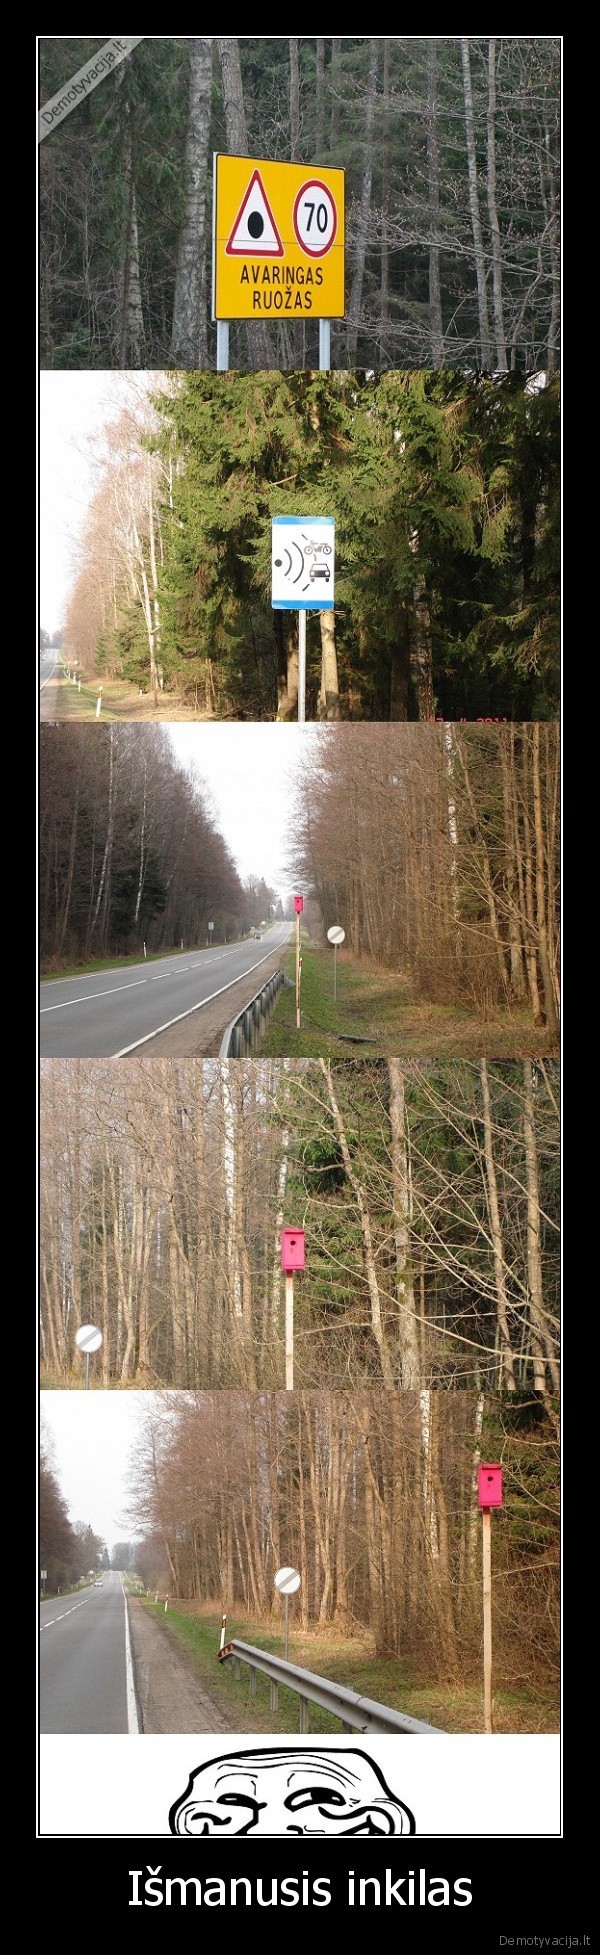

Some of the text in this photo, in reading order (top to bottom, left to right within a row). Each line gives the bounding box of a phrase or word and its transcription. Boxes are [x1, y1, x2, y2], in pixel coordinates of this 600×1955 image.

[304, 202, 328, 233] 70
[240, 264, 323, 286] AVARINGAS
[253, 286, 313, 310] RUOŽAS
